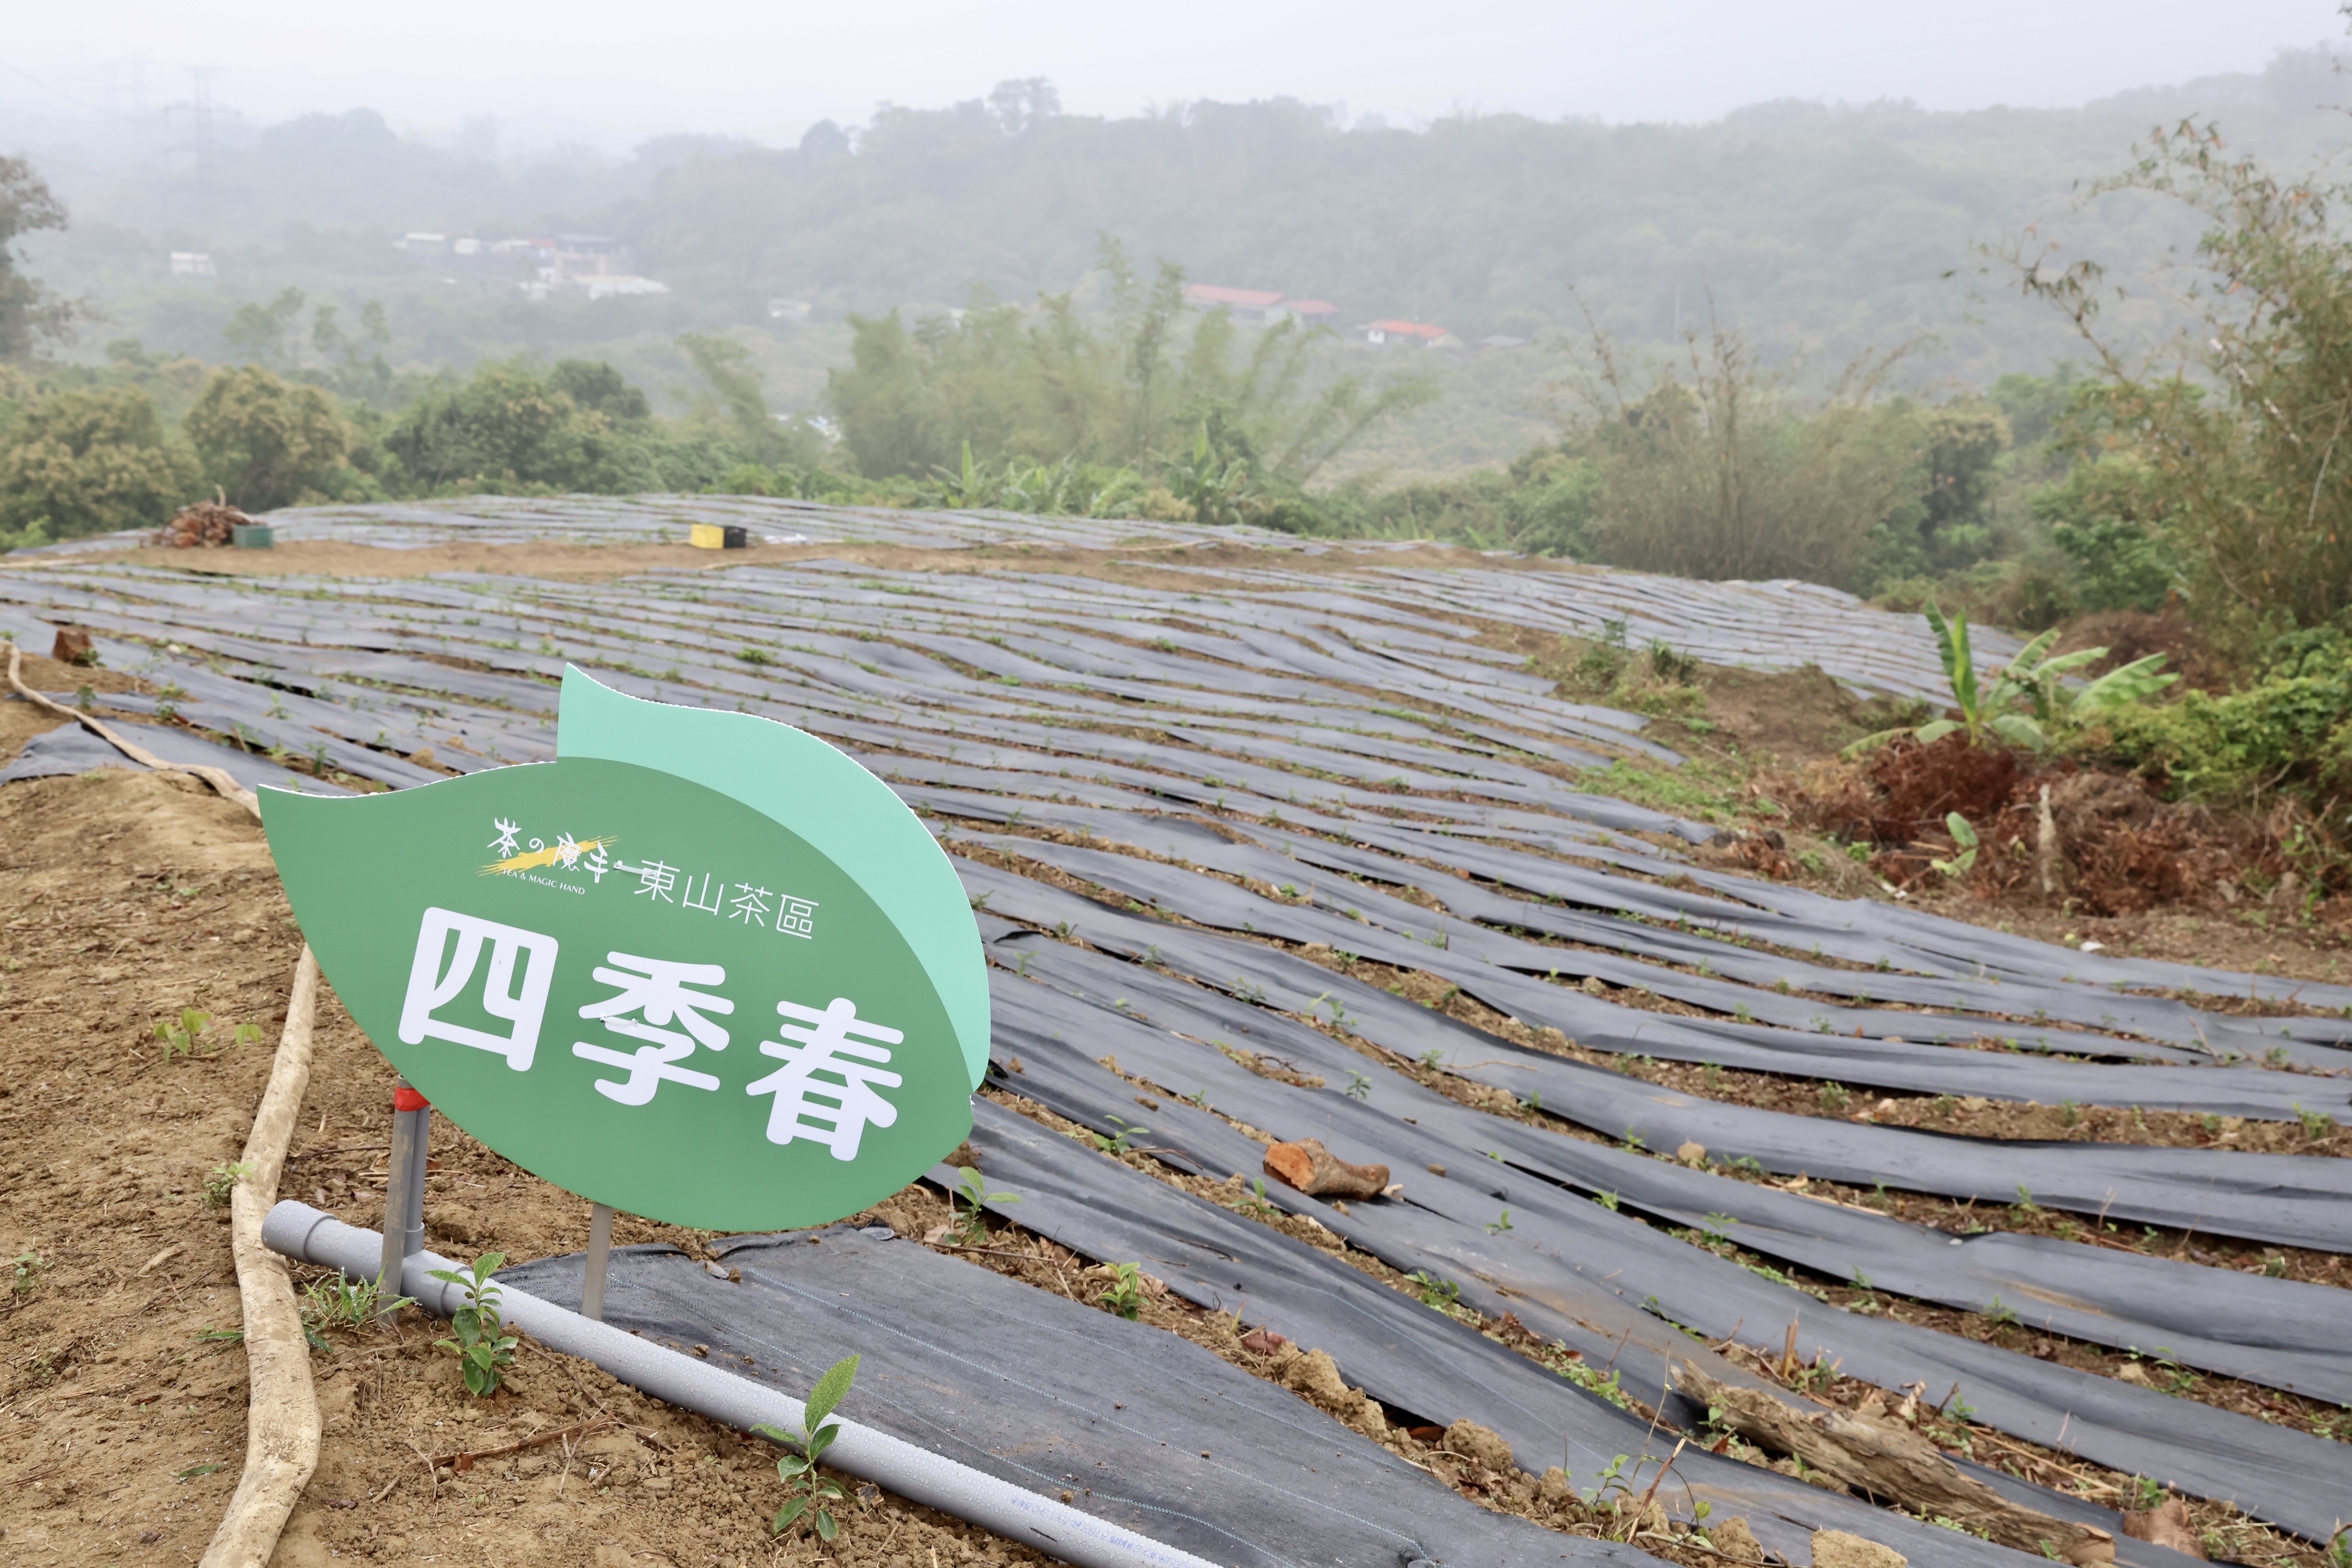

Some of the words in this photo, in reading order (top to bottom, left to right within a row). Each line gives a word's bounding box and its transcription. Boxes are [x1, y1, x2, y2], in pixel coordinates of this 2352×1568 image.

[487, 817, 609, 884] 茶の魔手
[501, 868, 518, 879] TEA
[520, 872, 527, 880] &
[528, 874, 558, 888] MAGIC
[559, 882, 586, 895] HAND
[634, 859, 819, 939] 東山茶區
[398, 906, 904, 1161] 四季春
